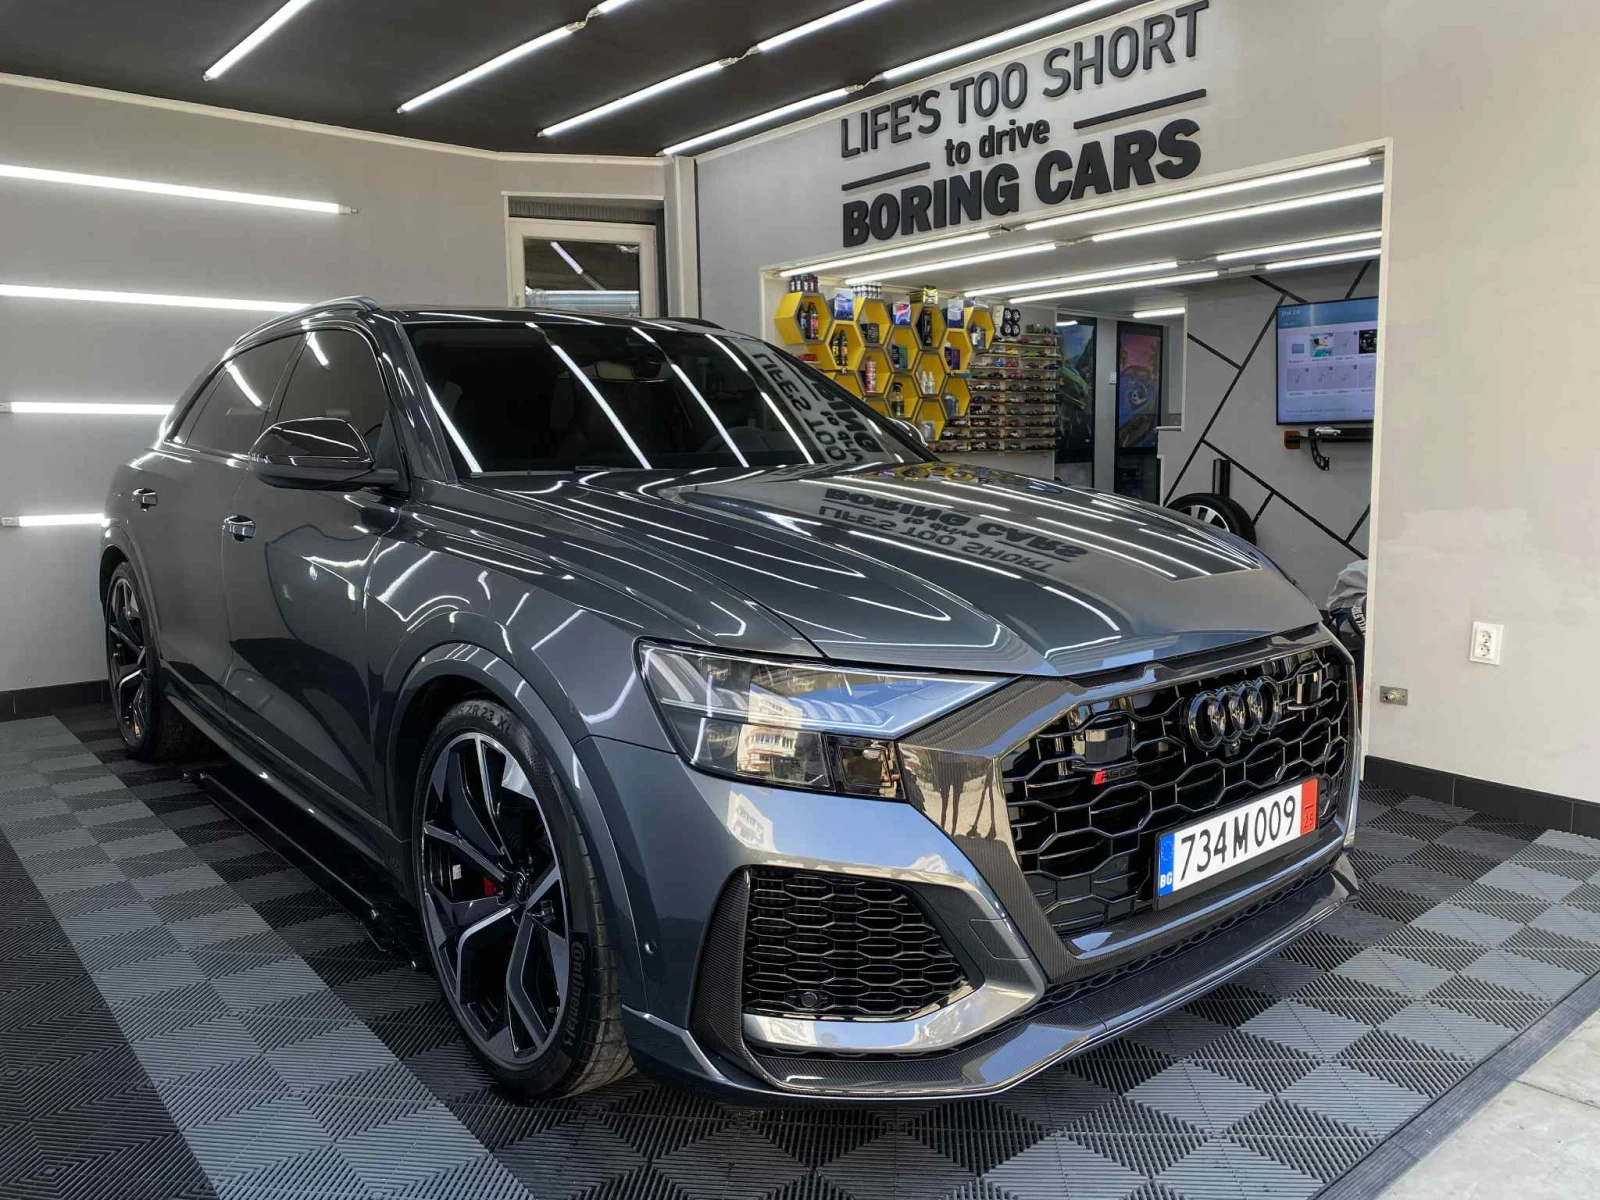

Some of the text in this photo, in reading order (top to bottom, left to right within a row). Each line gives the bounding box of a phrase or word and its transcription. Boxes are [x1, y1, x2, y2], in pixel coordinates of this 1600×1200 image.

[840, 3, 1209, 158] LIFE'S TOO SHORT
[842, 119, 1201, 248] BORING CARS
[945, 119, 1050, 166] to drive
[1160, 871, 1173, 888] BG
[564, 941, 586, 1039] Continental
